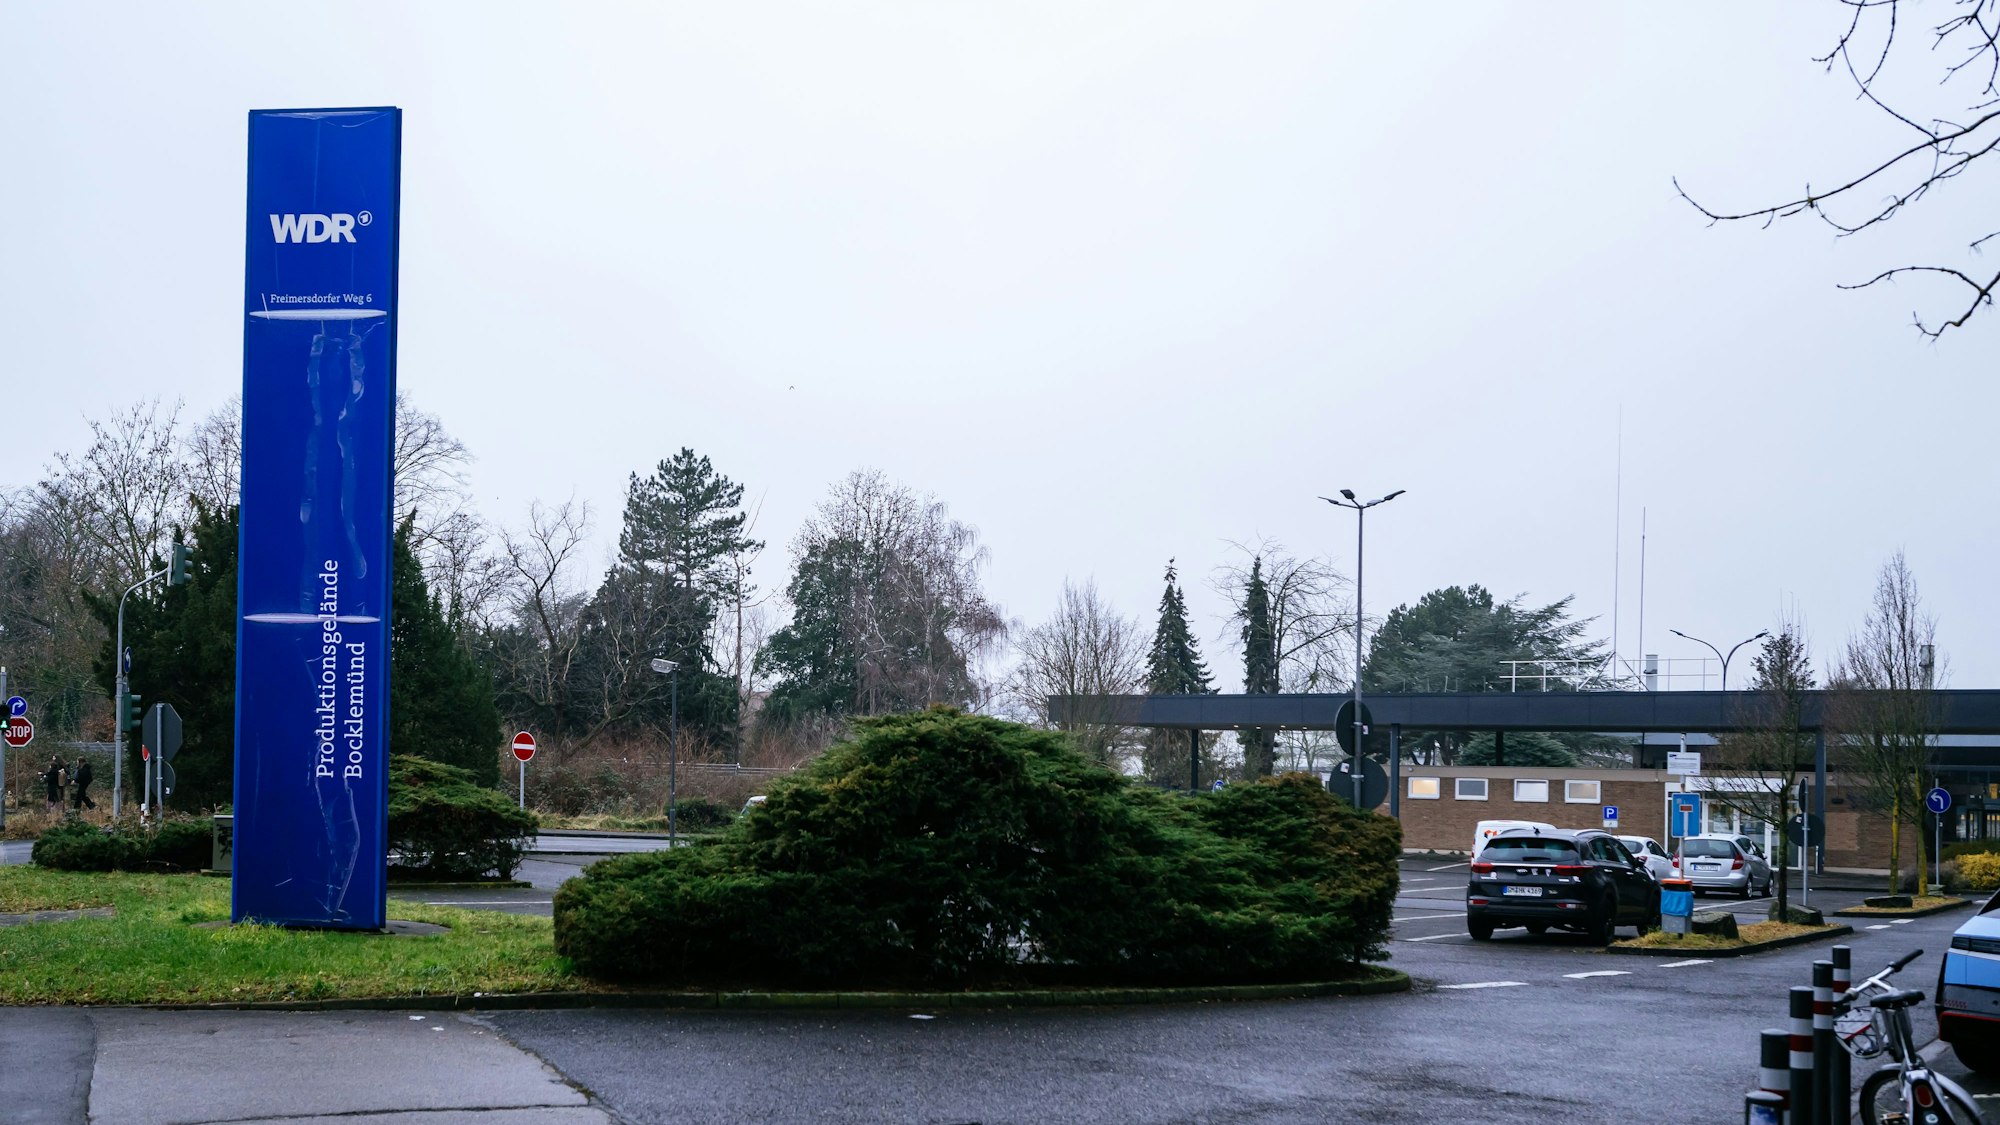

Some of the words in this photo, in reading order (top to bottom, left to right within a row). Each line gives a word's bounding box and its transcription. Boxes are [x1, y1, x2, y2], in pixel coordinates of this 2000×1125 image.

[269, 213, 357, 244] WDR
[270, 293, 341, 304] Freimersdorfer
[343, 293, 364, 305] Weg
[366, 293, 372, 303] 6
[316, 558, 342, 778] Produktionsgelände
[344, 641, 366, 779] Bocklemünd
[5, 726, 31, 738] STOP
[1606, 808, 1615, 818] P
